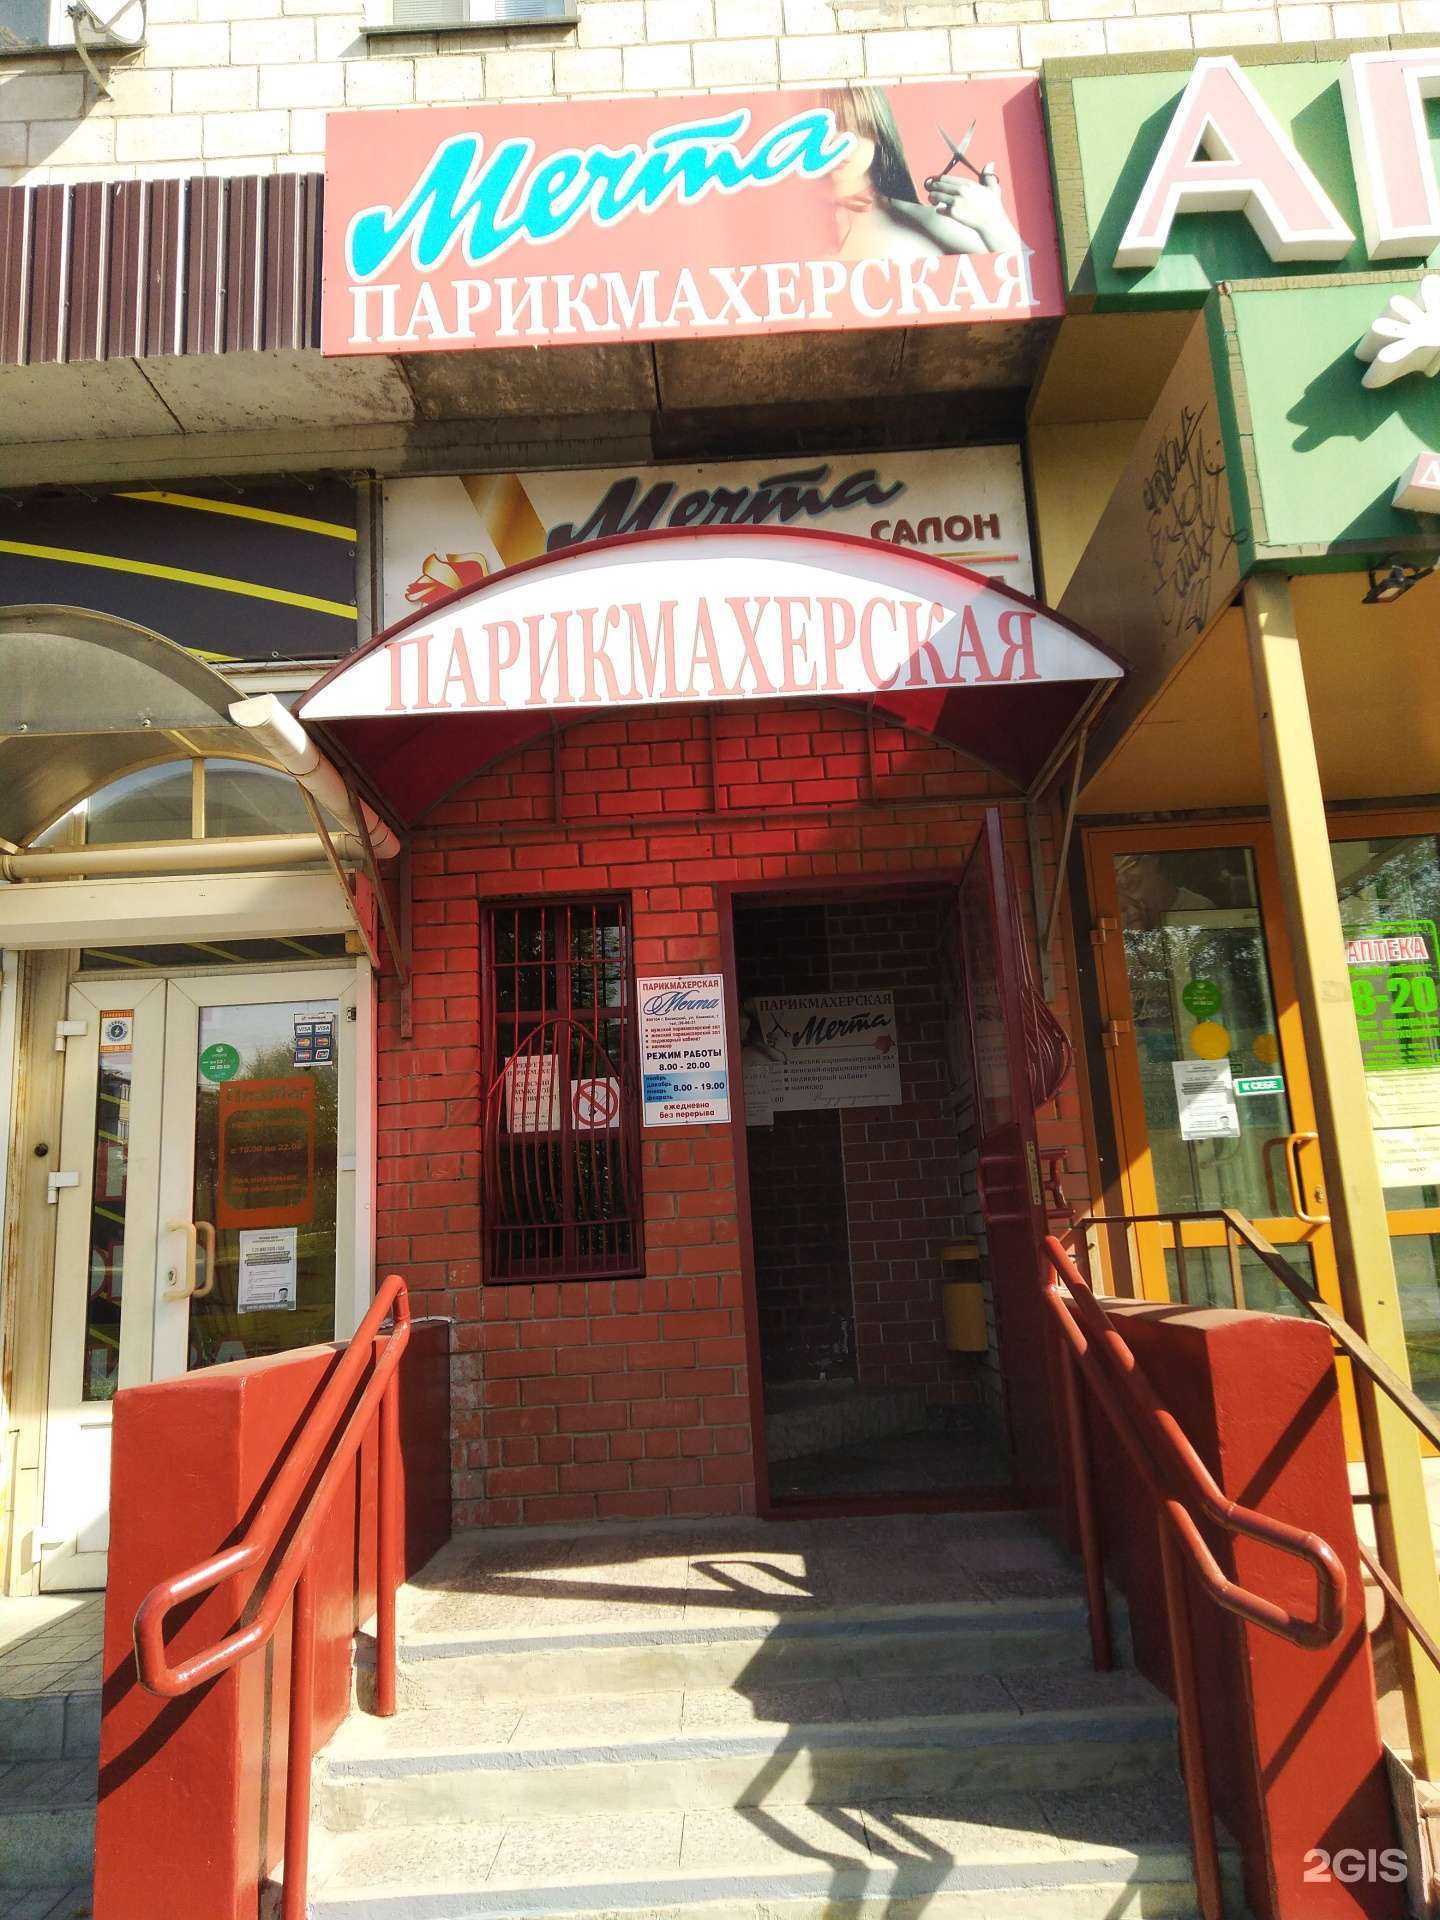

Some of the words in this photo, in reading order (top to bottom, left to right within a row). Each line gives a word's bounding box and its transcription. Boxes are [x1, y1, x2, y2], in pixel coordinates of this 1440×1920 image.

[346, 108, 857, 282] Мечта
[348, 249, 1040, 343] ПАРИКМАХЕРСКАЯ
[547, 464, 906, 553] Мечта
[870, 512, 1000, 546] САЛОН
[384, 595, 1042, 711] ПАРИКМАХЕРСКАЯ
[1346, 938, 1427, 962] АПТЕКА
[642, 979, 719, 991] ПАРИКМАХЕРСКАЯ
[643, 990, 720, 1016] Мечта
[760, 993, 894, 1012] ПАРИКМАХЕРСКАЯ
[792, 1011, 891, 1047] Мечта
[646, 1051, 682, 1060] РЕЖИМ
[684, 1049, 722, 1059] РАБОТЫ
[659, 1063, 677, 1071] 8.00
[686, 1061, 710, 1070] 20.00
[673, 1083, 692, 1092] 8.00
[701, 1081, 725, 1091] 19.00
[659, 1110, 674, 1119] без
[675, 1110, 715, 1120] перерыва
[664, 1102, 710, 1111] ежедневно
